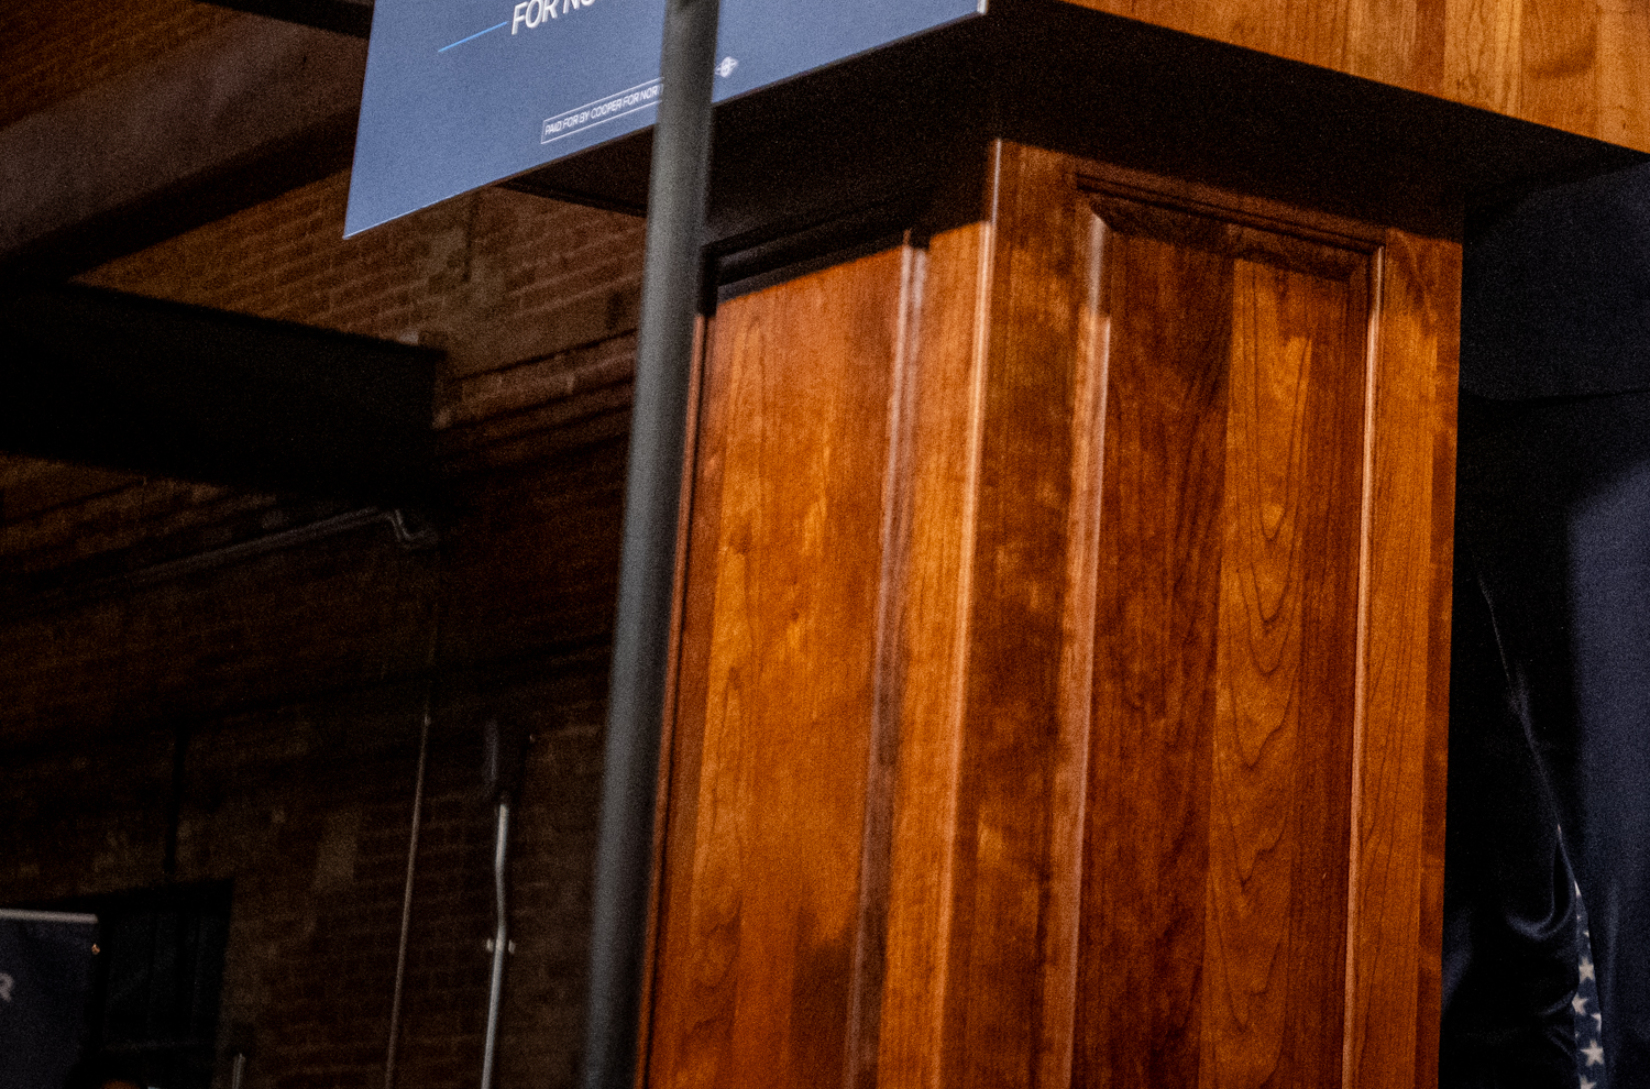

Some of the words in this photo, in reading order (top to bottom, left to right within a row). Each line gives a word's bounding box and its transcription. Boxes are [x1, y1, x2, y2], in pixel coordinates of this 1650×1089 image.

[545, 120, 562, 135] PAID
[562, 114, 579, 129] FOR
[579, 110, 590, 123] BY
[591, 99, 622, 119] COOPER
[622, 92, 640, 108] FOR
[640, 83, 663, 101] NOR
